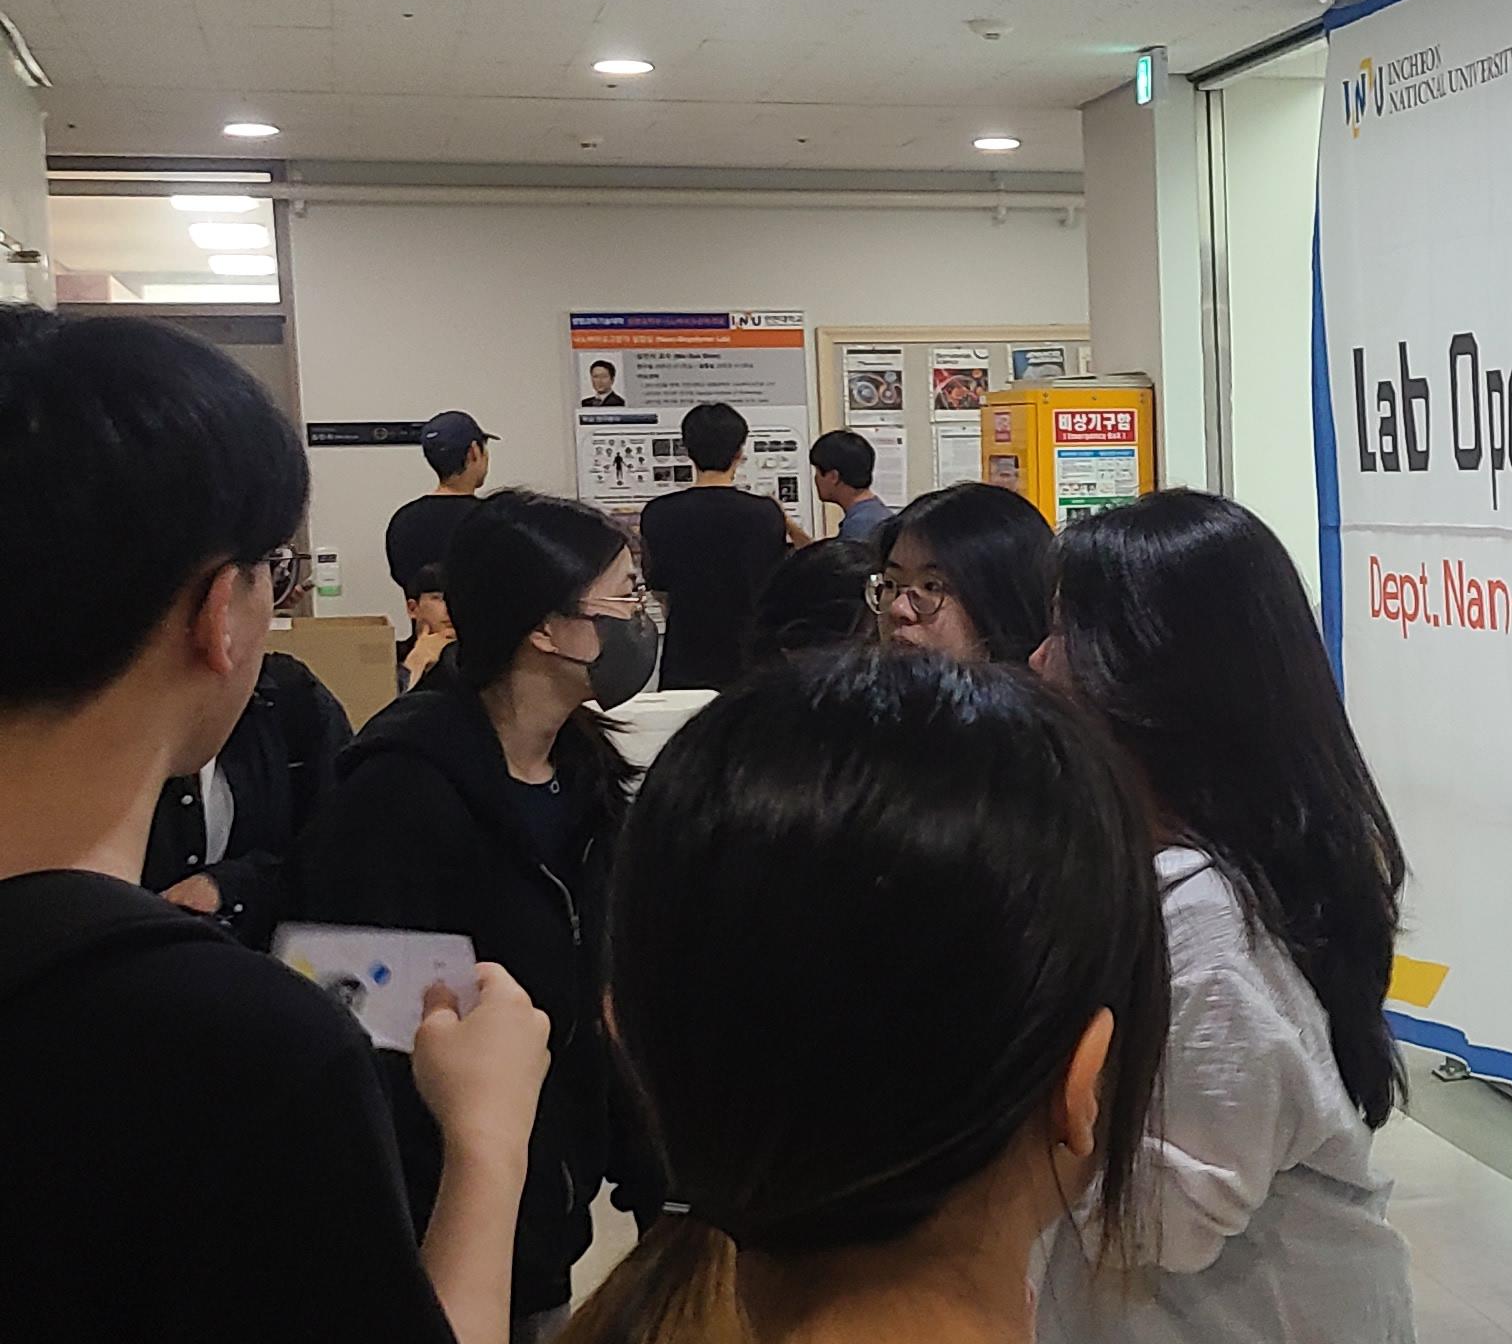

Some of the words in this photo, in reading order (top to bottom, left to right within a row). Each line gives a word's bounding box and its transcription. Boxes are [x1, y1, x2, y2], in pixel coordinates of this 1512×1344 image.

[1388, 43, 1441, 86] INCHEON
[1389, 73, 1447, 115] NATIONAL
[731, 314, 762, 327] INU
[1058, 413, 1132, 432] 비상기구함
[1352, 340, 1431, 473] Lab
